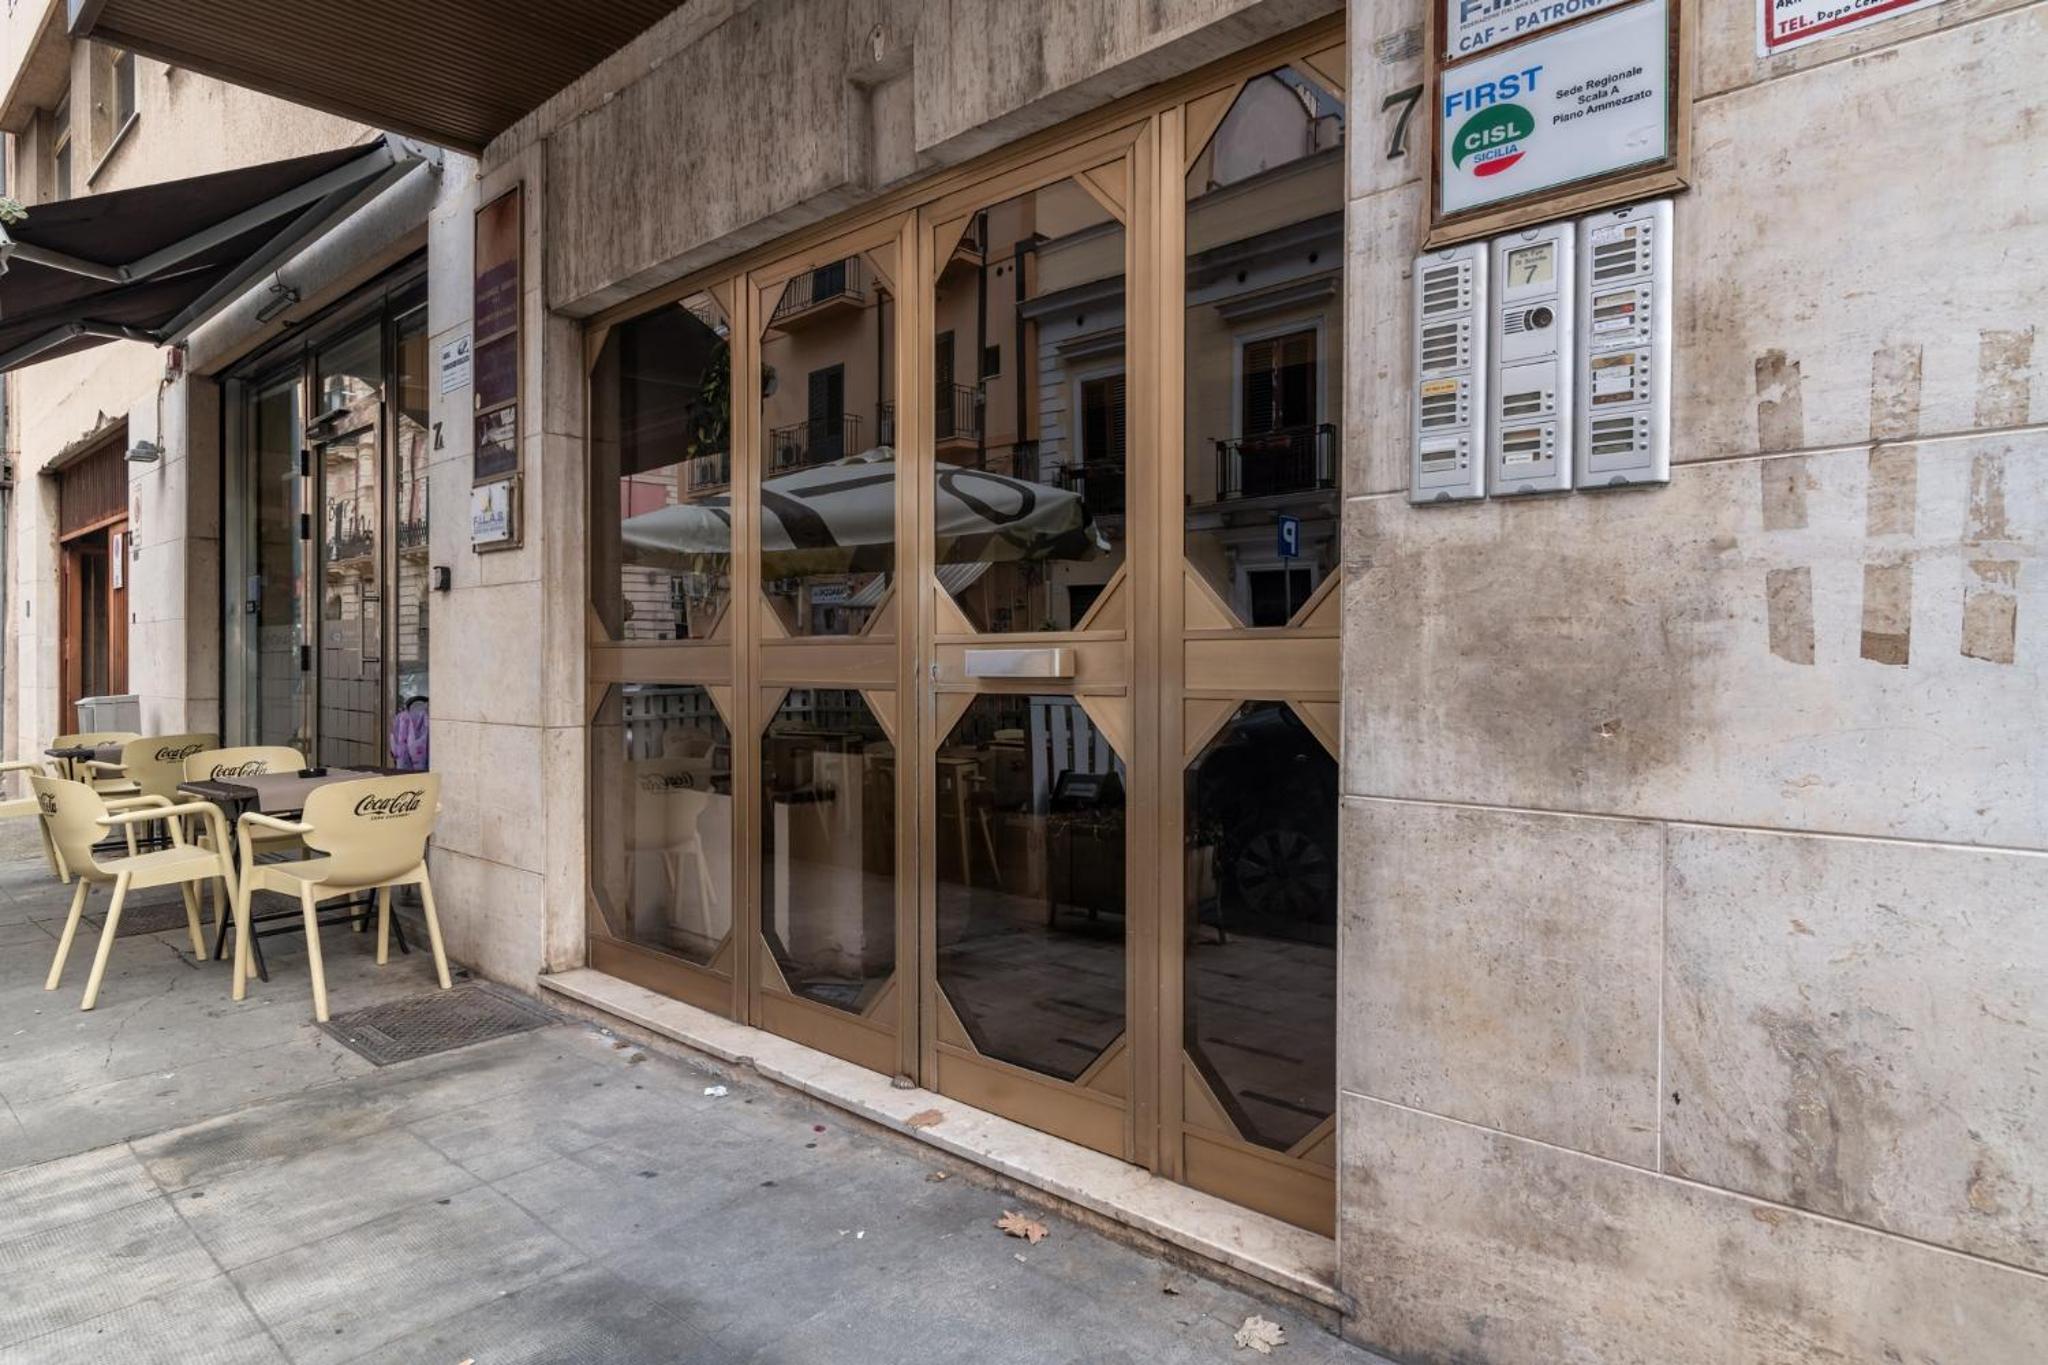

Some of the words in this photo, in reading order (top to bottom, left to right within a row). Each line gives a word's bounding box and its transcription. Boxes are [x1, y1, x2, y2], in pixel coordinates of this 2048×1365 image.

[1459, 27, 1495, 51] CAF
[1515, 0, 1603, 32] PATRON
[1778, 15, 1814, 33] TEL.
[1445, 65, 1543, 118] FIRST
[1556, 85, 1583, 99] Sede
[1586, 67, 1643, 90] Regionale
[1578, 90, 1608, 105] Scala
[1611, 85, 1619, 97] A
[1381, 83, 1424, 160] 7
[1553, 110, 1583, 126] Piano
[1586, 89, 1653, 115] Ammezzato
[1464, 122, 1521, 150] CISL
[1473, 144, 1518, 163] SICILIA
[1524, 264, 1538, 284] 7
[353, 790, 425, 816] Coca-Cola
